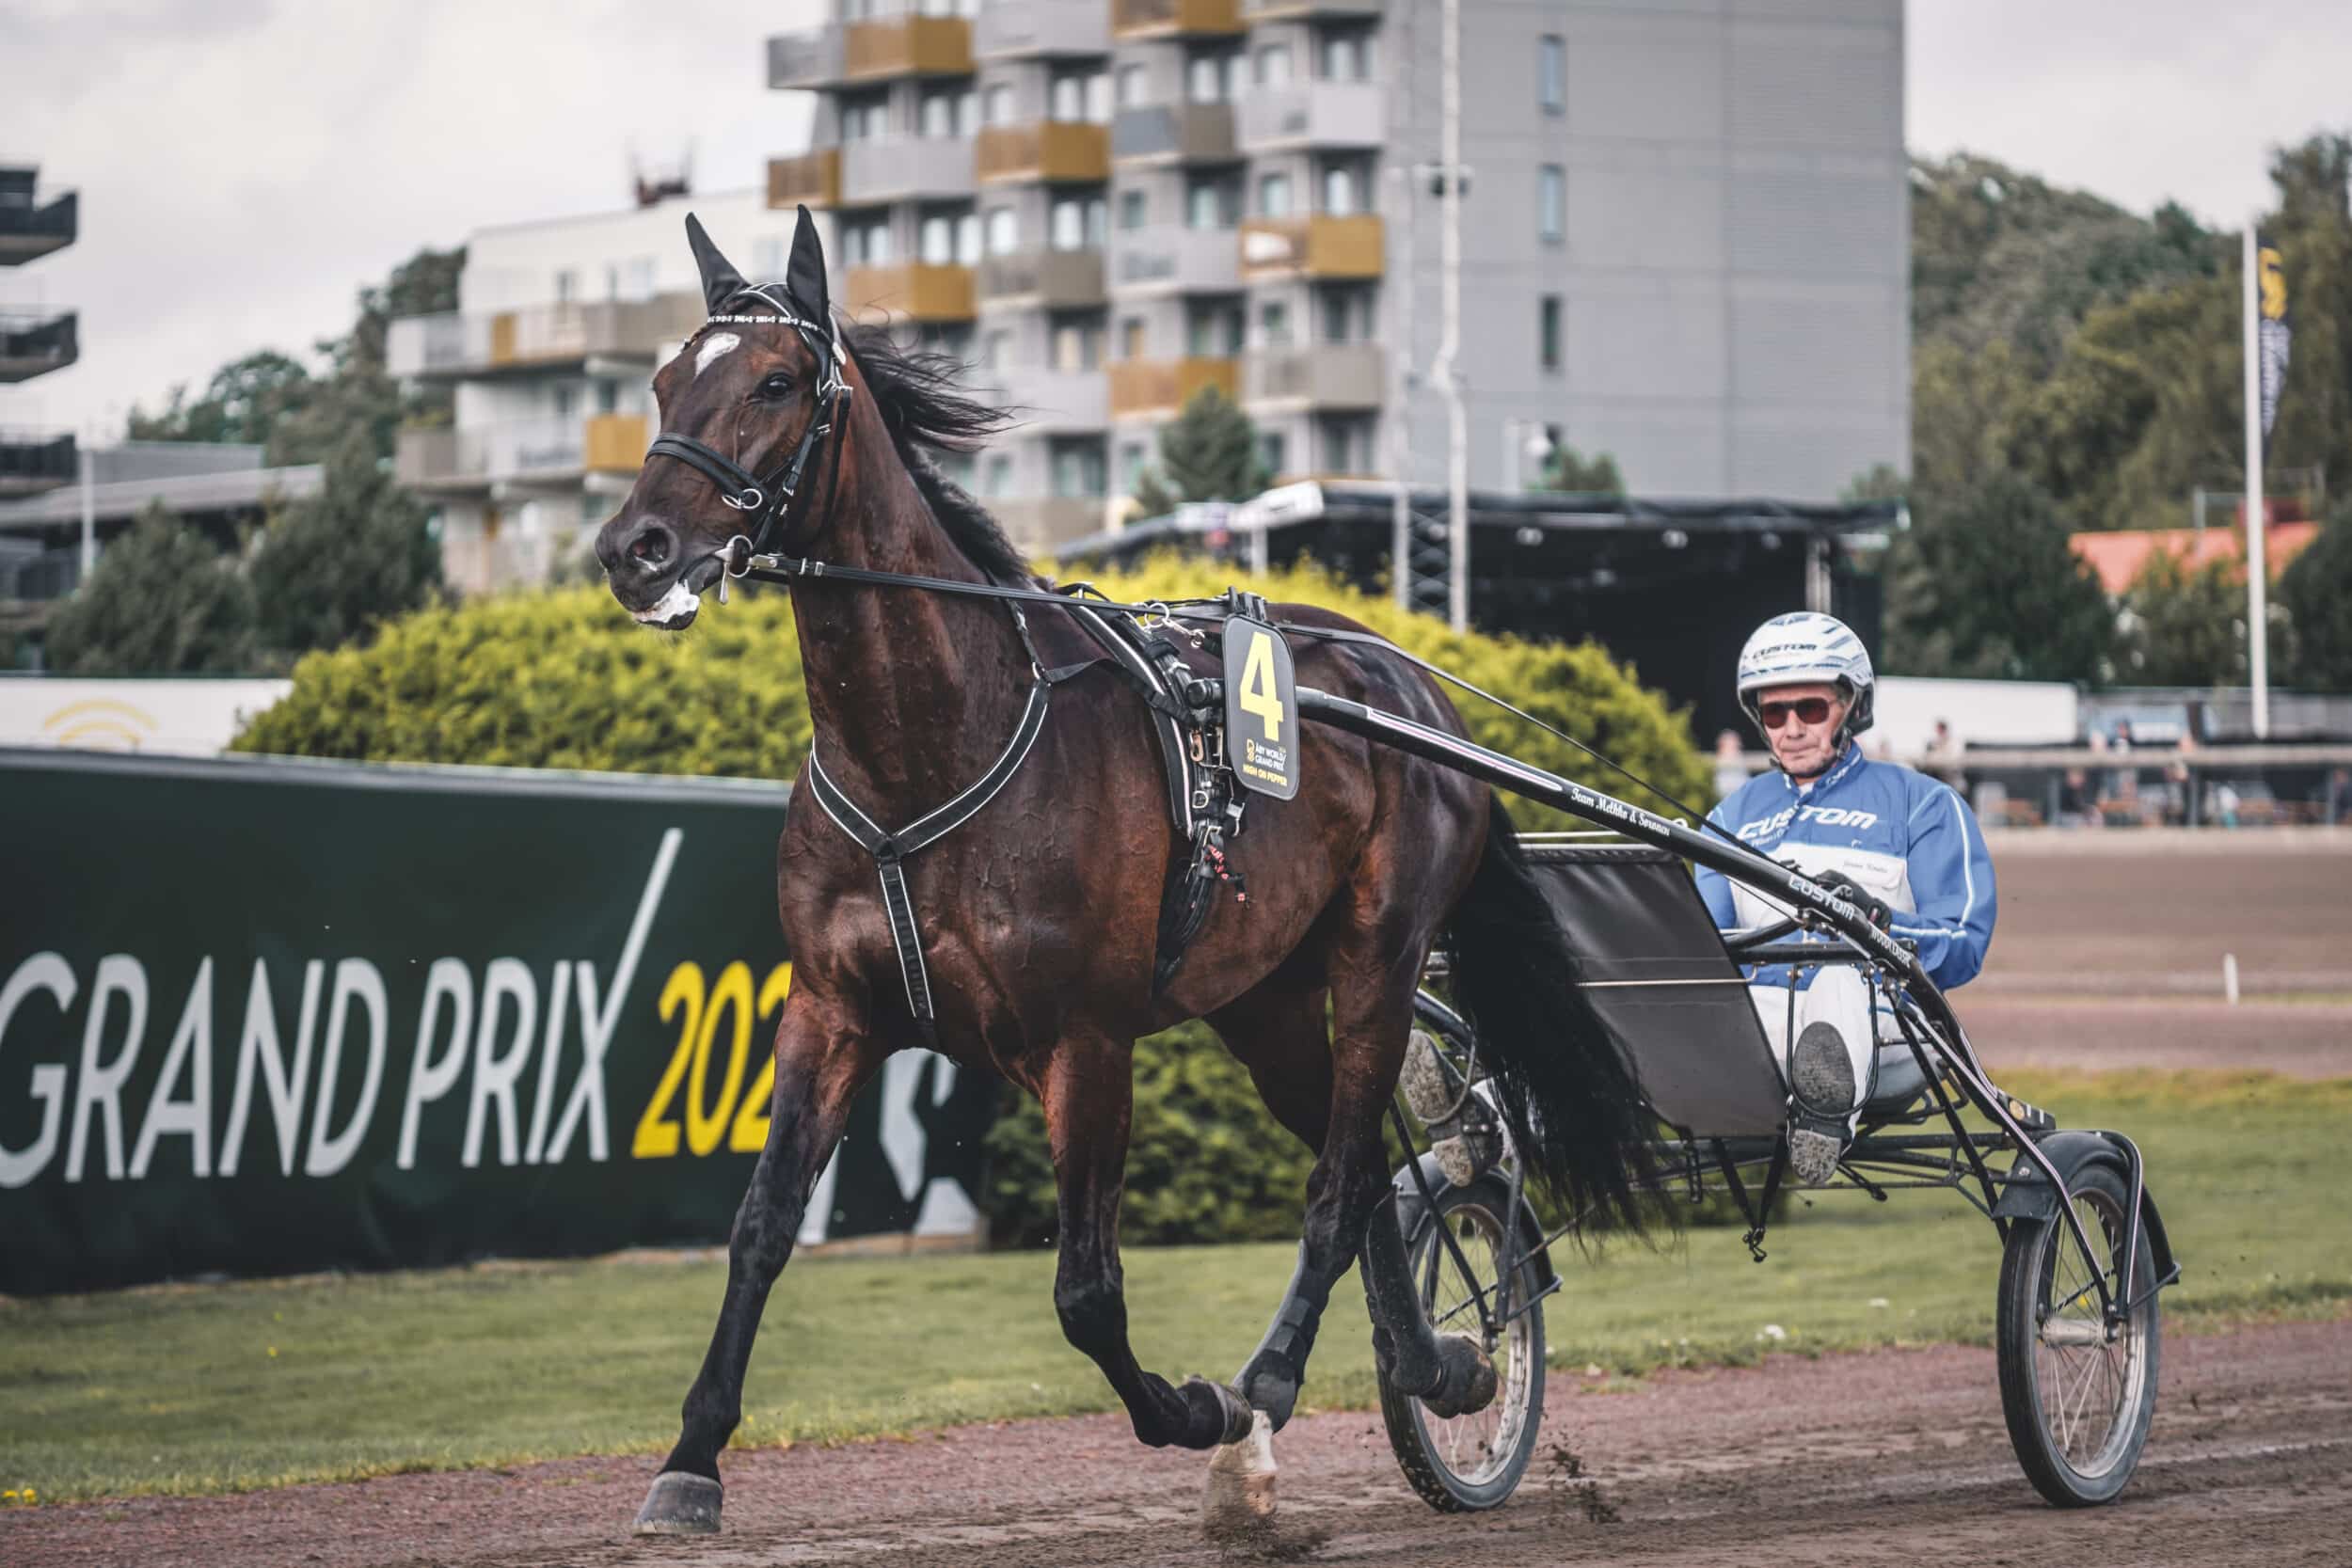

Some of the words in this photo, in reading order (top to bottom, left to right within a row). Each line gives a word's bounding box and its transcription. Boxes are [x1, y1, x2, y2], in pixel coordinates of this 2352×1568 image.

[1753, 642, 1818, 659] CUSTOM
[1240, 631, 1284, 742] 4
[1571, 787, 1595, 808] Team
[1735, 800, 1878, 840] CUSTOM
[1788, 874, 1855, 922] CUSTOM
[0, 952, 389, 1189] GRAND
[396, 828, 684, 1169] PRIX
[631, 959, 793, 1160] 202
